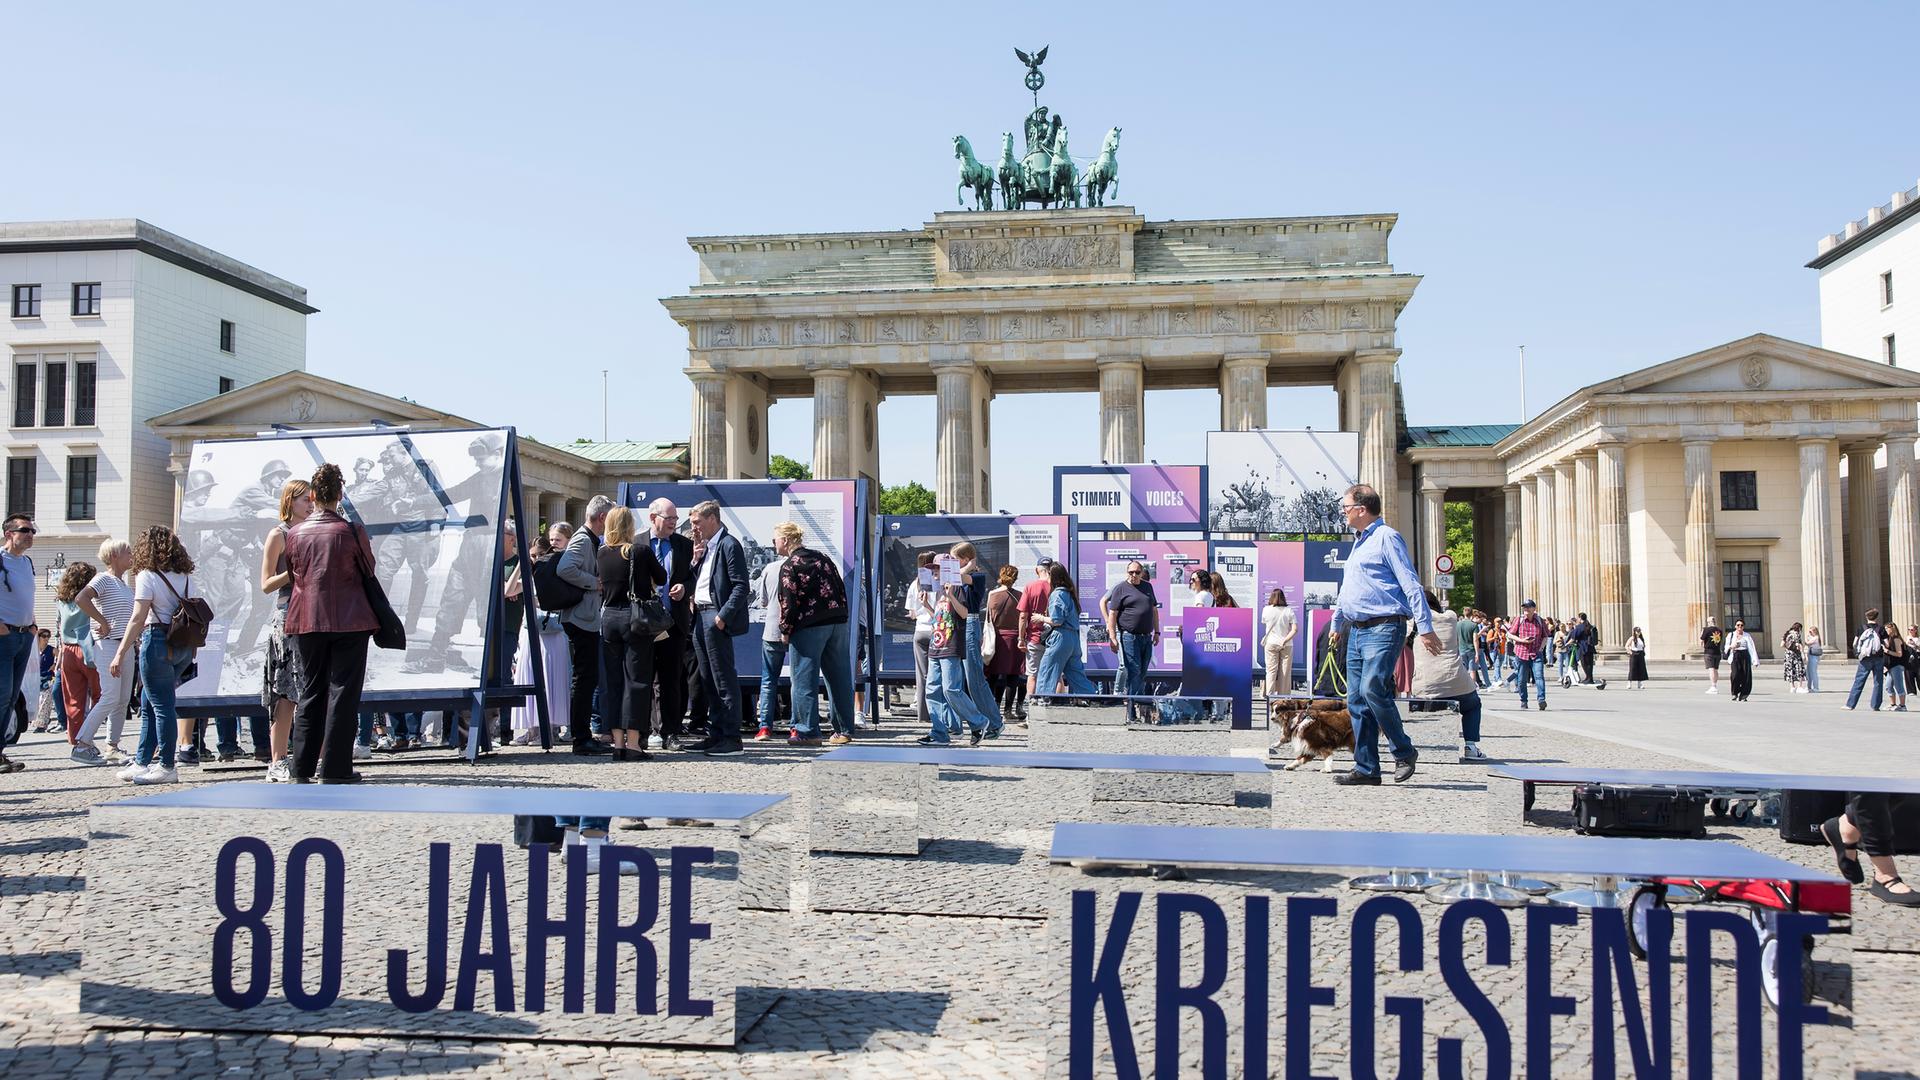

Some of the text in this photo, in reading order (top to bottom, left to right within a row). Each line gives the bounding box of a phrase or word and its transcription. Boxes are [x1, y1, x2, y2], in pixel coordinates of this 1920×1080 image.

[1071, 491, 1121, 507] STIMMEN
[1146, 490, 1184, 507] VOICES
[1195, 632, 1212, 643] JAHRE
[1204, 643, 1237, 652] KRIEGSENDE
[211, 836, 715, 1017] 80 JAHRE
[1069, 889, 1830, 1080] KRIEGSENDE
